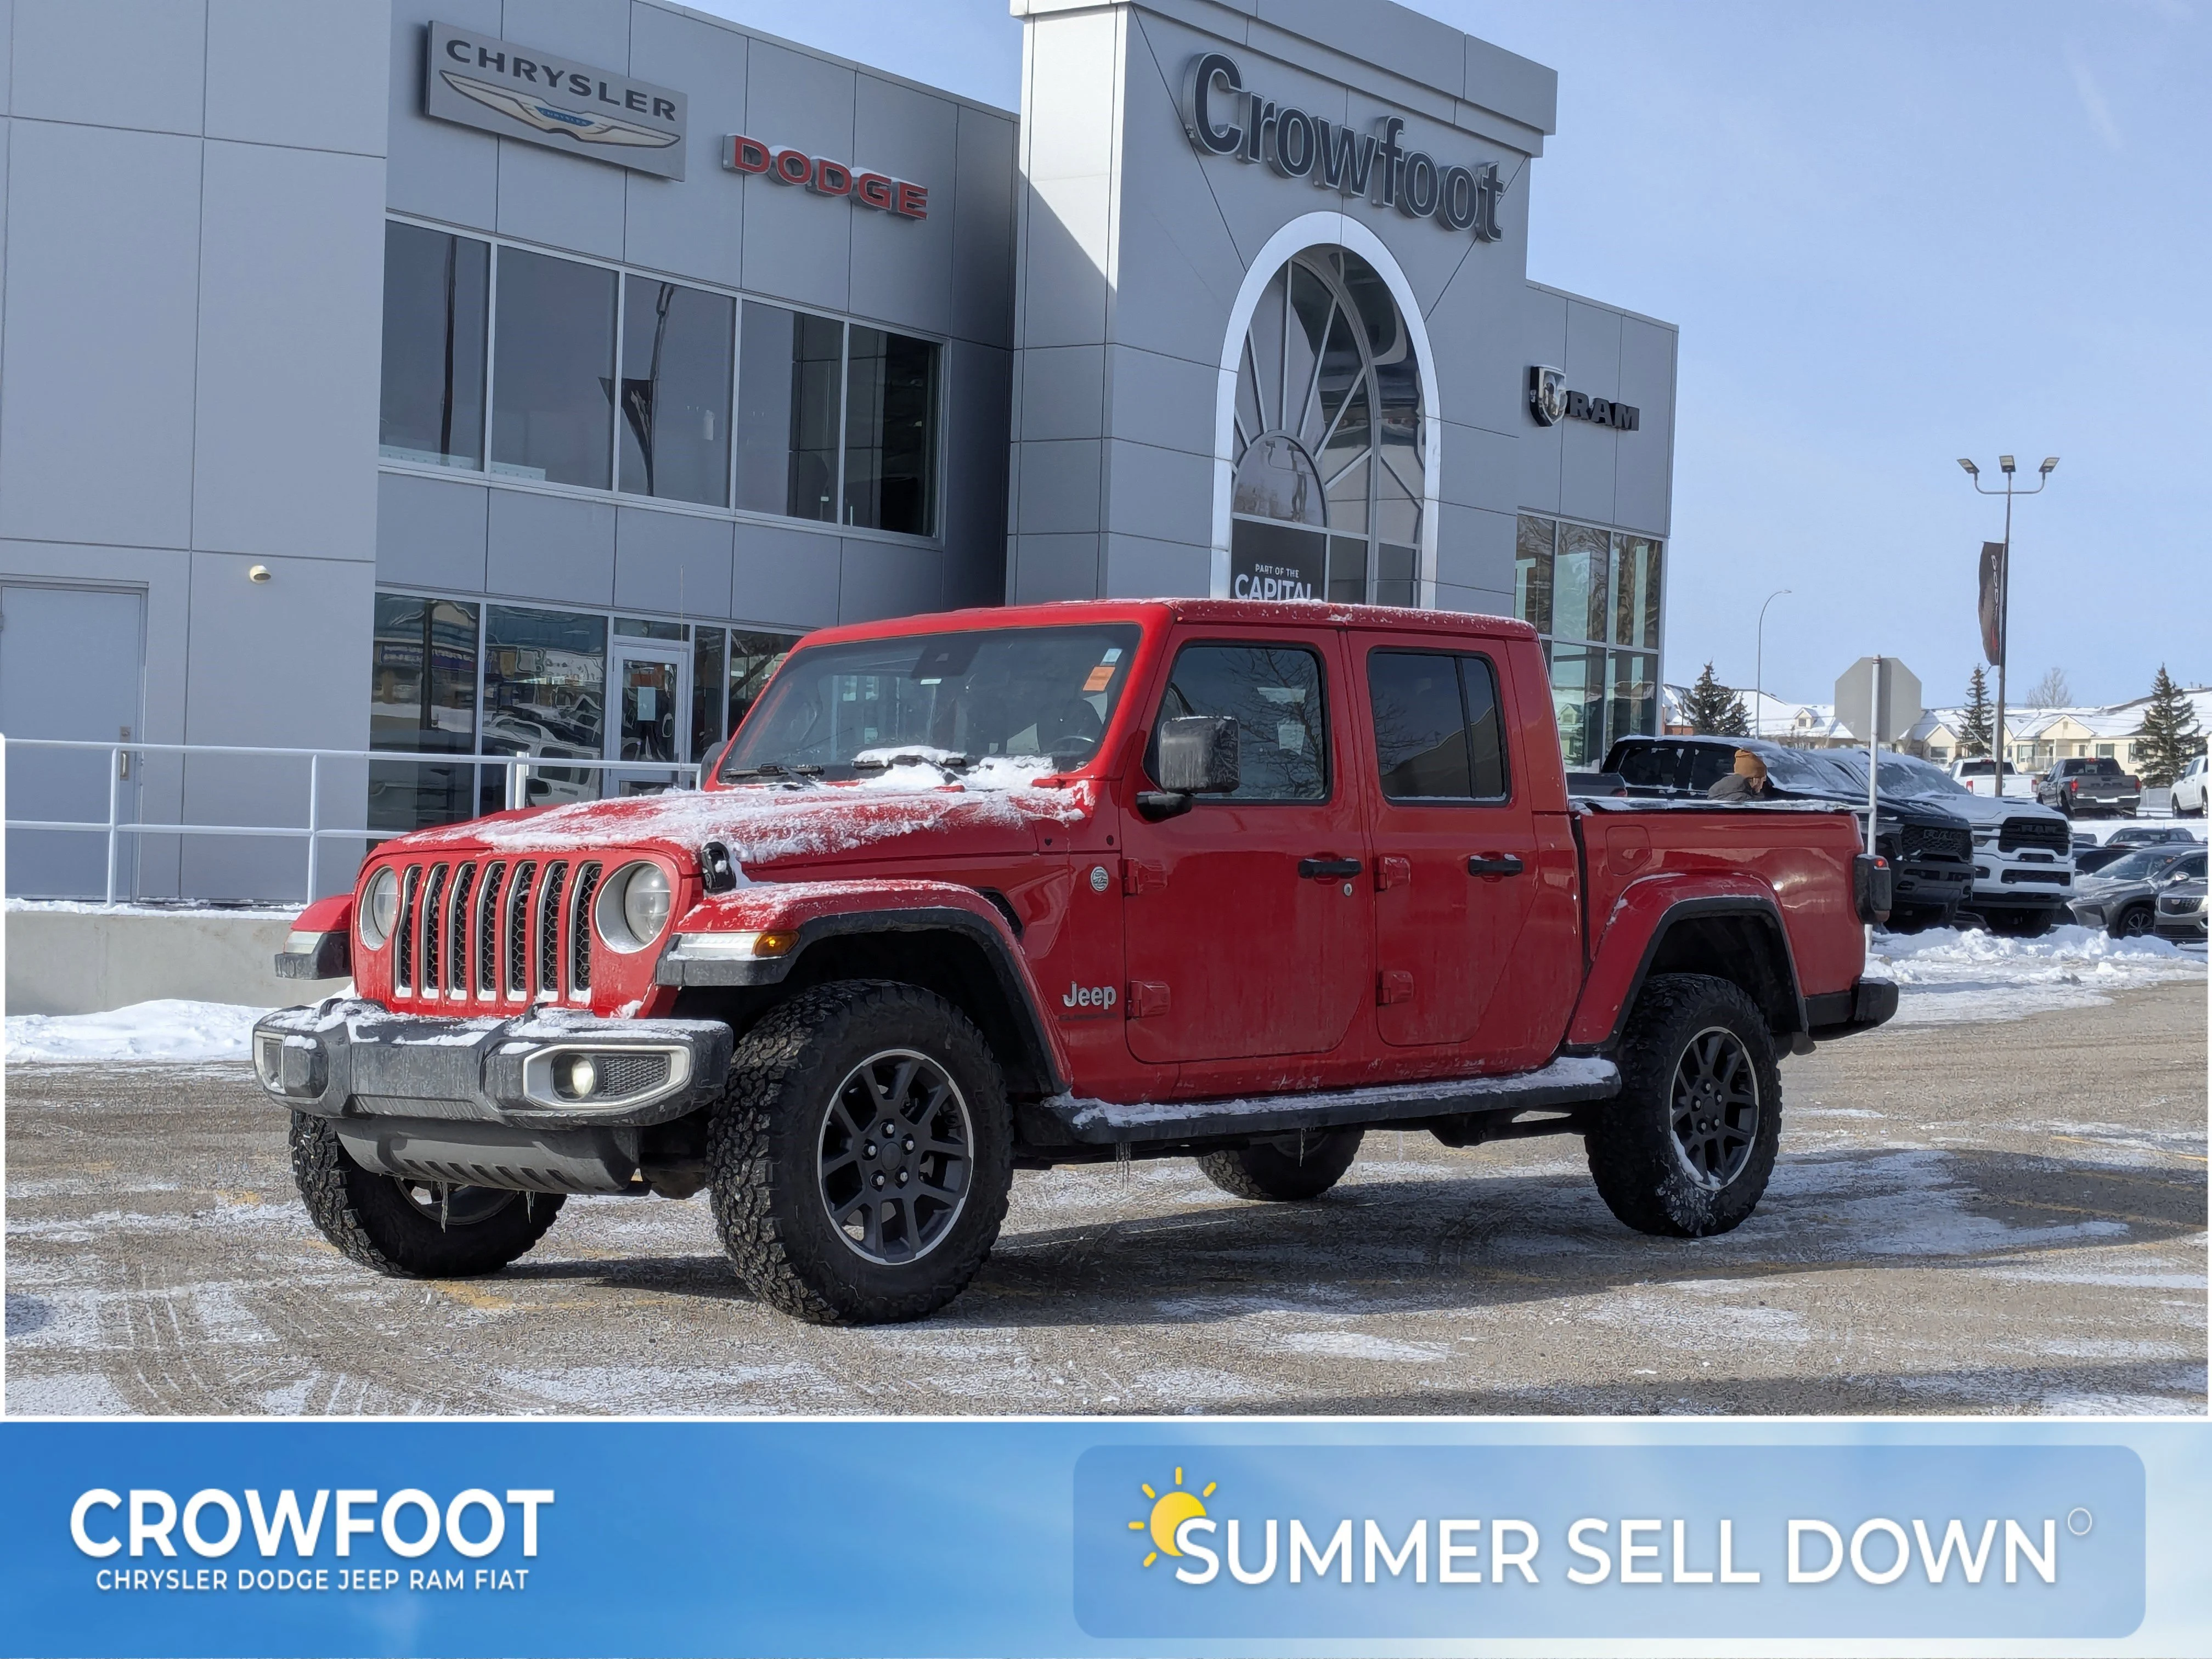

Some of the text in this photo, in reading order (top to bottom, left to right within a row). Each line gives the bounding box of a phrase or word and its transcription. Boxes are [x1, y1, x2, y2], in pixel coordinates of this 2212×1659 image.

[445, 38, 677, 122] CHRYSLER
[732, 135, 929, 220] DODGE
[1192, 52, 1505, 242] Crowfoot
[1570, 390, 1640, 431] RAM
[1255, 563, 1299, 578] PART OF THE
[1062, 980, 1116, 1010] Jeep
